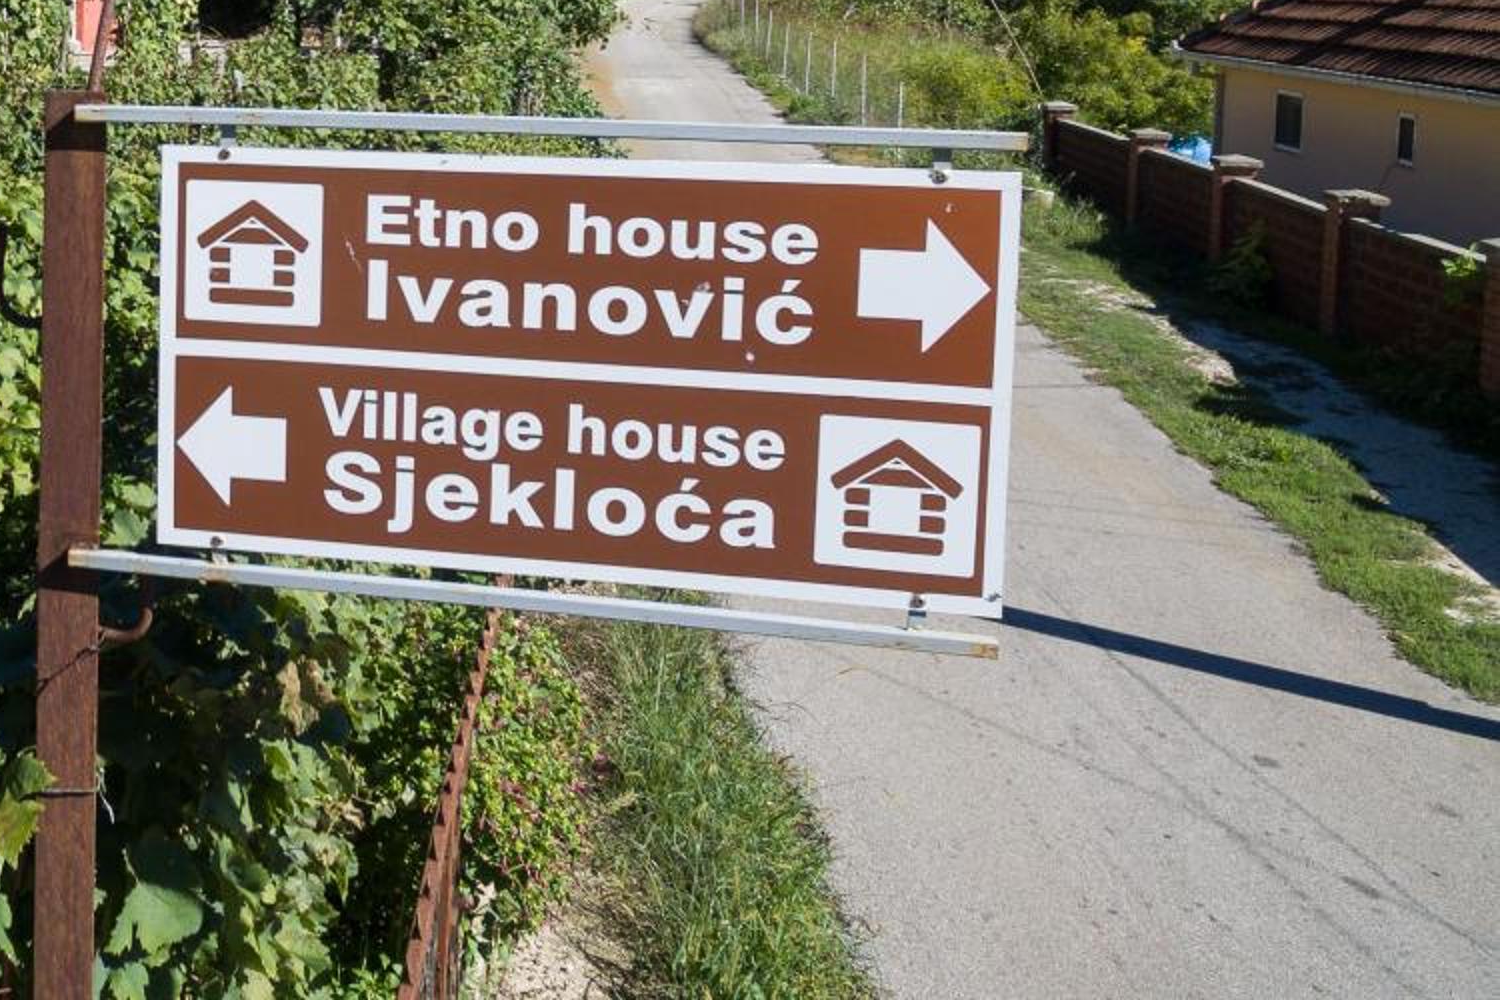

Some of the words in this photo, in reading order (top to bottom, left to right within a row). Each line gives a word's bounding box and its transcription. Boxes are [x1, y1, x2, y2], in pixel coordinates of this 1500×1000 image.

[366, 194, 539, 252] Etno
[567, 203, 819, 265] house
[367, 260, 814, 345] Ivanović
[318, 387, 543, 461] Village
[567, 404, 786, 471] house
[323, 451, 776, 549] Sjekloća
